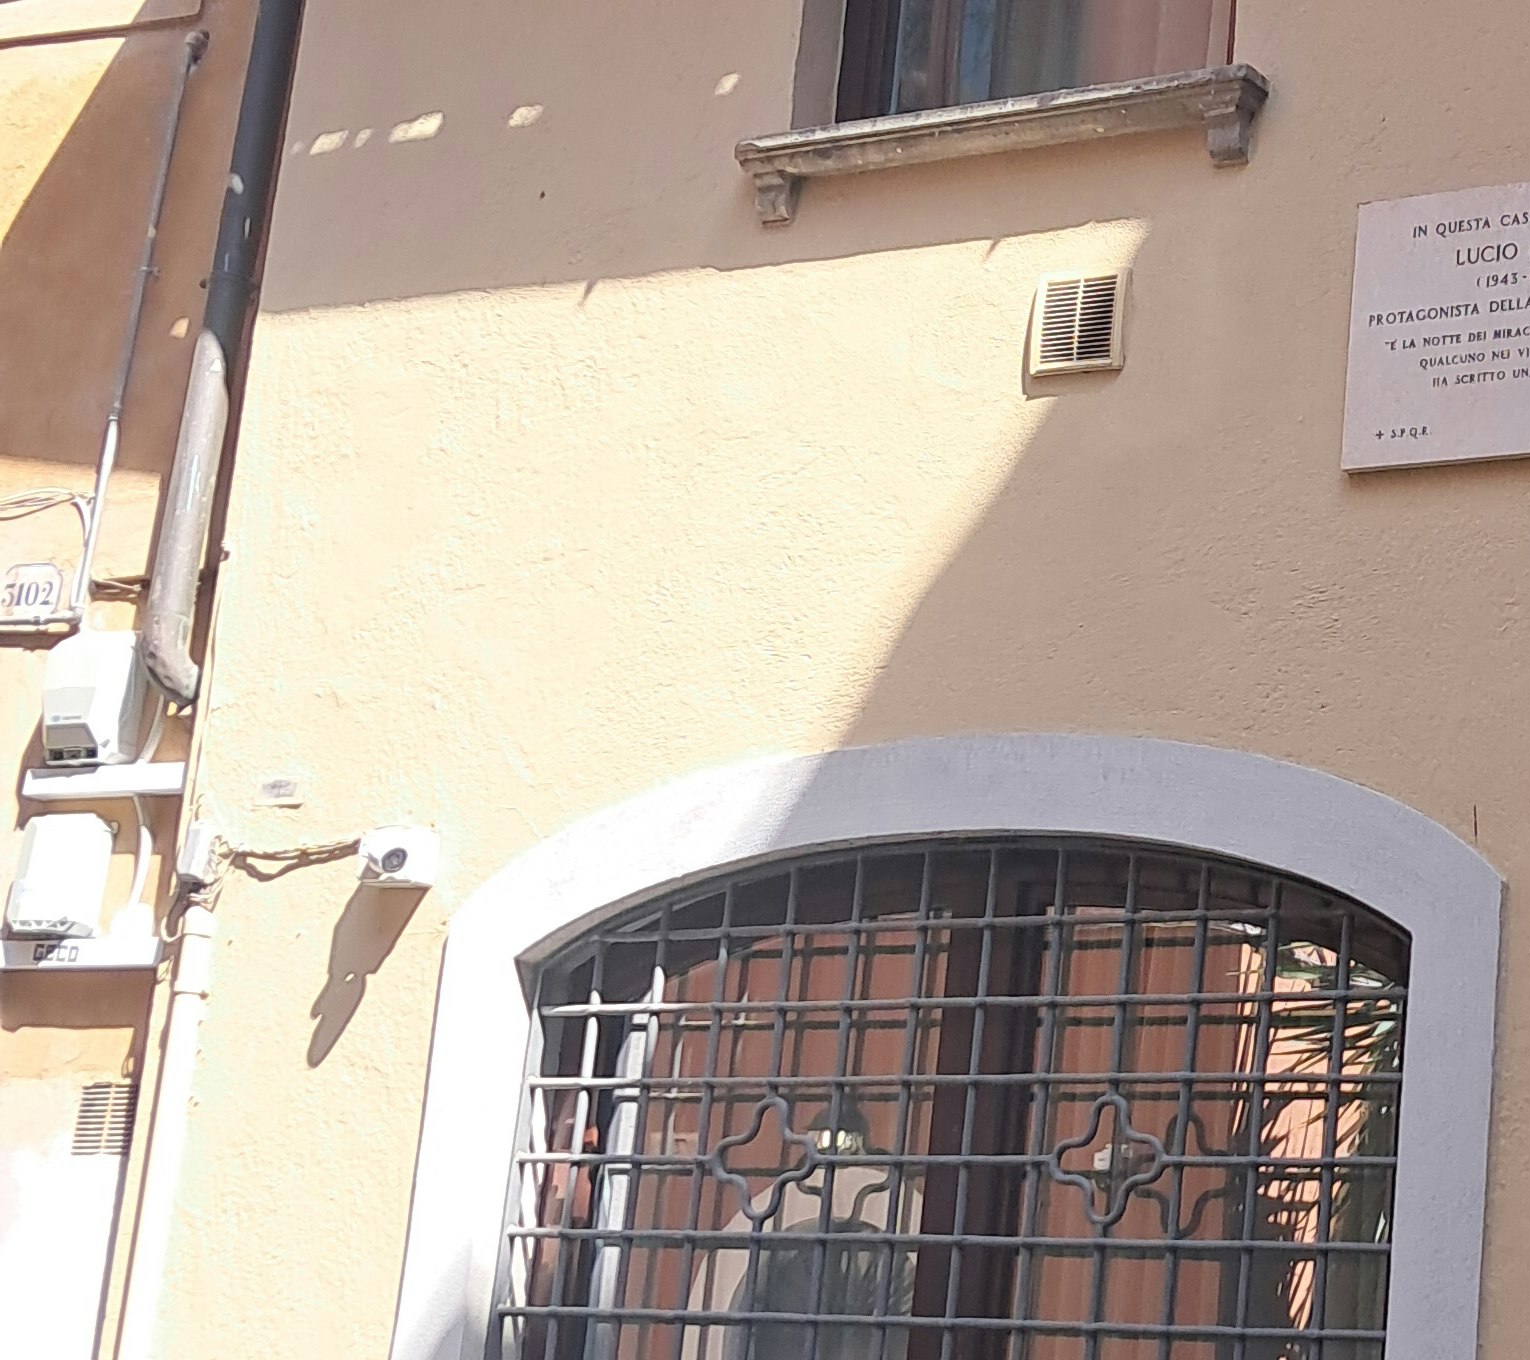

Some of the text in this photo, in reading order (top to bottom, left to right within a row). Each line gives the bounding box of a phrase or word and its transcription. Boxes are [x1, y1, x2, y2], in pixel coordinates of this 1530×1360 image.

[1412, 224, 1428, 239] IN
[1435, 217, 1491, 238] QUESTA
[1456, 242, 1518, 266] LUCIO
[1368, 303, 1480, 327] PROTAGONISTA
[1402, 338, 1416, 349] LA
[1423, 333, 1462, 347] NOTTE
[1468, 330, 1487, 343] DEI
[1419, 352, 1485, 370] QUALCUNO
[1491, 349, 1511, 361] NEI
[1432, 376, 1448, 388] HA
[1454, 370, 1505, 385] SCRITTO
